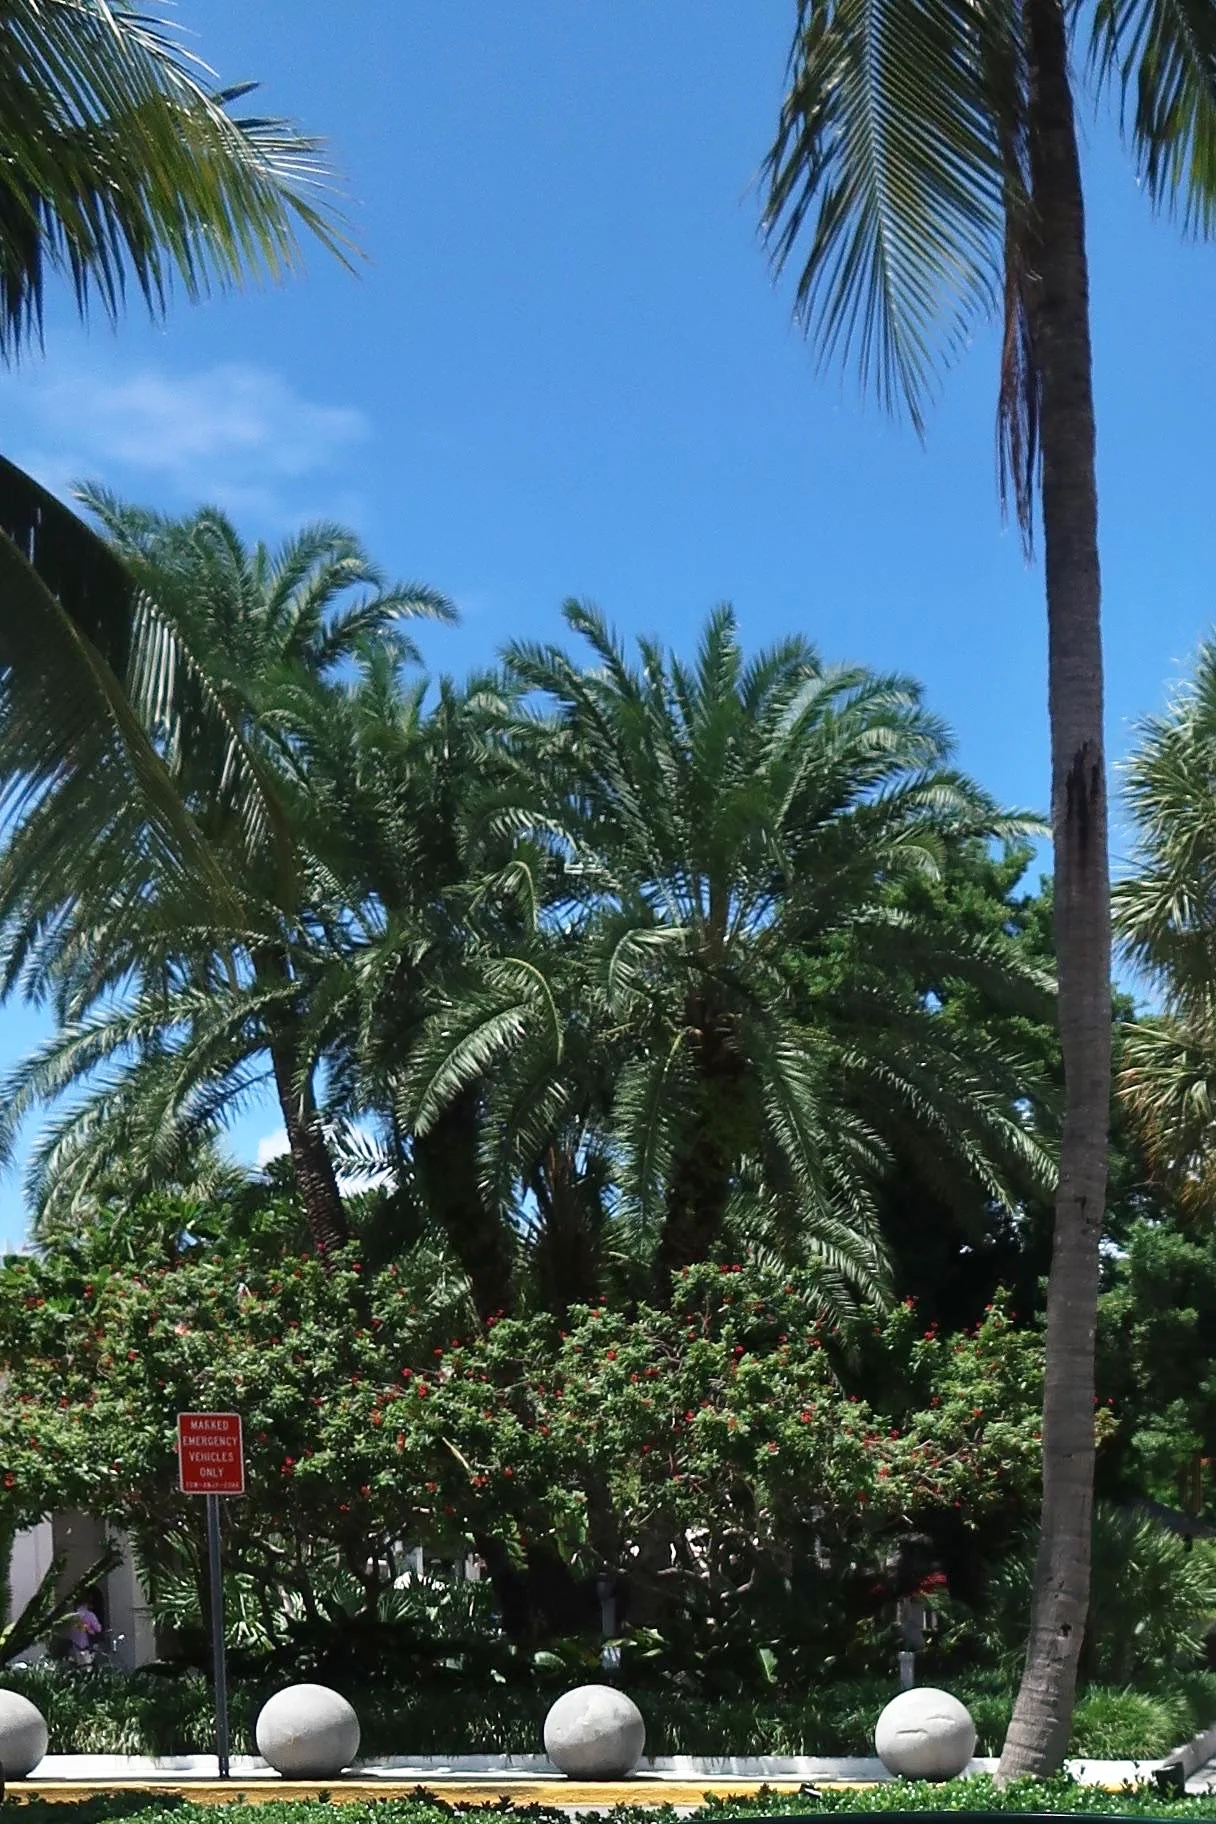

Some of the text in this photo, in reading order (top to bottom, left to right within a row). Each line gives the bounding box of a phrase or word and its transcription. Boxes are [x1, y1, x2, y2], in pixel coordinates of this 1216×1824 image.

[190, 1420, 229, 1430] MARKED
[182, 1435, 238, 1447] EMERGENCY
[188, 1451, 234, 1463] VEHICLES
[199, 1467, 224, 1478] ONLY
